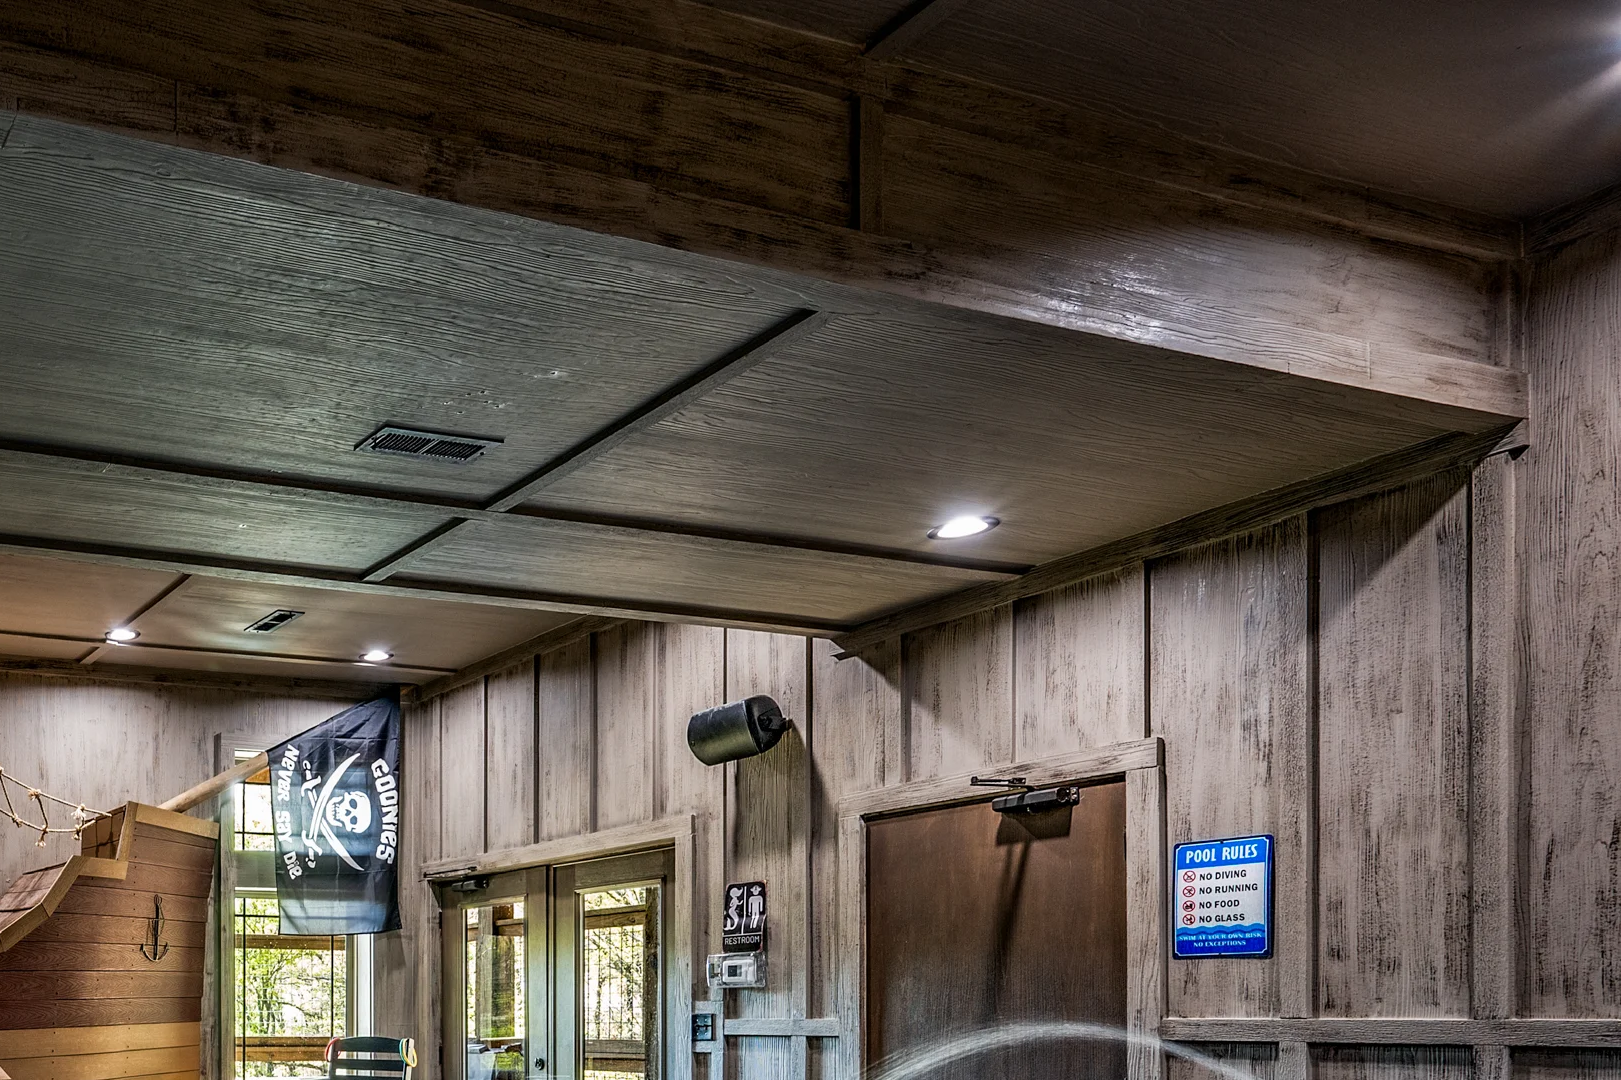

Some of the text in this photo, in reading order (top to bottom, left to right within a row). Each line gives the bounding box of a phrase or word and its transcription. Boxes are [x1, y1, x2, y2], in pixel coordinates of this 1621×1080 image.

[1185, 844, 1258, 864] POOL RULES
[1199, 869, 1247, 881] NO DIVING
[1199, 883, 1258, 895] NO RUNNING
[1199, 899, 1240, 909] NO FOOD
[1199, 913, 1245, 923] NO GLASS
[724, 935, 760, 945] RESTROOM
